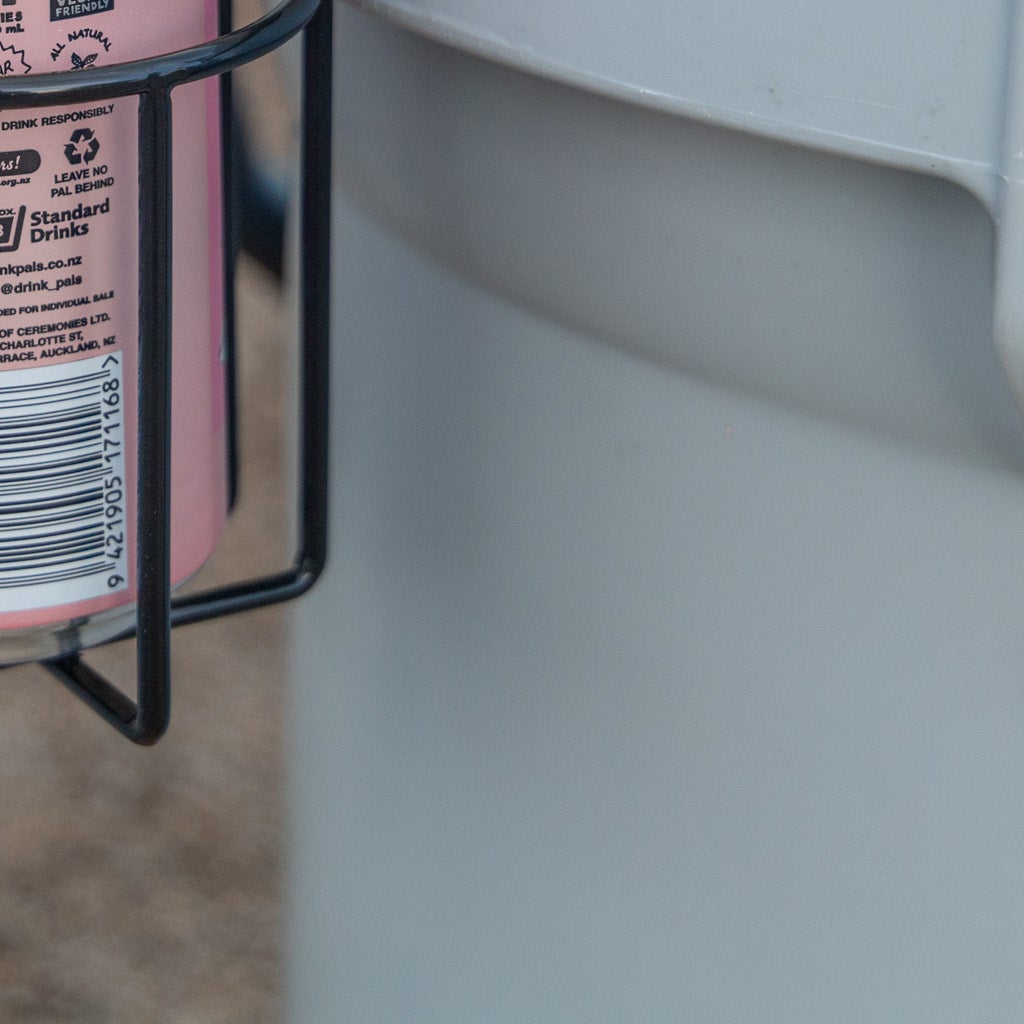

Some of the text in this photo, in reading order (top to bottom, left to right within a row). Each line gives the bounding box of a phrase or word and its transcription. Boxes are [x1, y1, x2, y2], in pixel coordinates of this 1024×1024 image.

[5, 23, 25, 34] mL
[50, 28, 112, 61] ALL NATURAL
[1, 118, 39, 131] DRINK
[41, 104, 115, 127] RESPONSIBLY
[54, 165, 108, 184] LEAVE NO
[51, 177, 115, 198] PAL BEHIND
[30, 198, 110, 227] Standard
[30, 221, 89, 243] Drinks
[1, 274, 83, 295] @drink_pals
[19, 305, 39, 315] FOR
[41, 296, 91, 312] INDIVIDUAL
[93, 290, 115, 302] SALE
[17, 317, 88, 337] CEREMONIES
[90, 313, 111, 325] LTD.
[0, 334, 66, 351] CHARLOTTE
[69, 331, 84, 342] ST,
[40, 339, 101, 359] AUCKLAND,
[103, 336, 117, 346] NZ
[102, 378, 125, 588] 9 421905 171168
